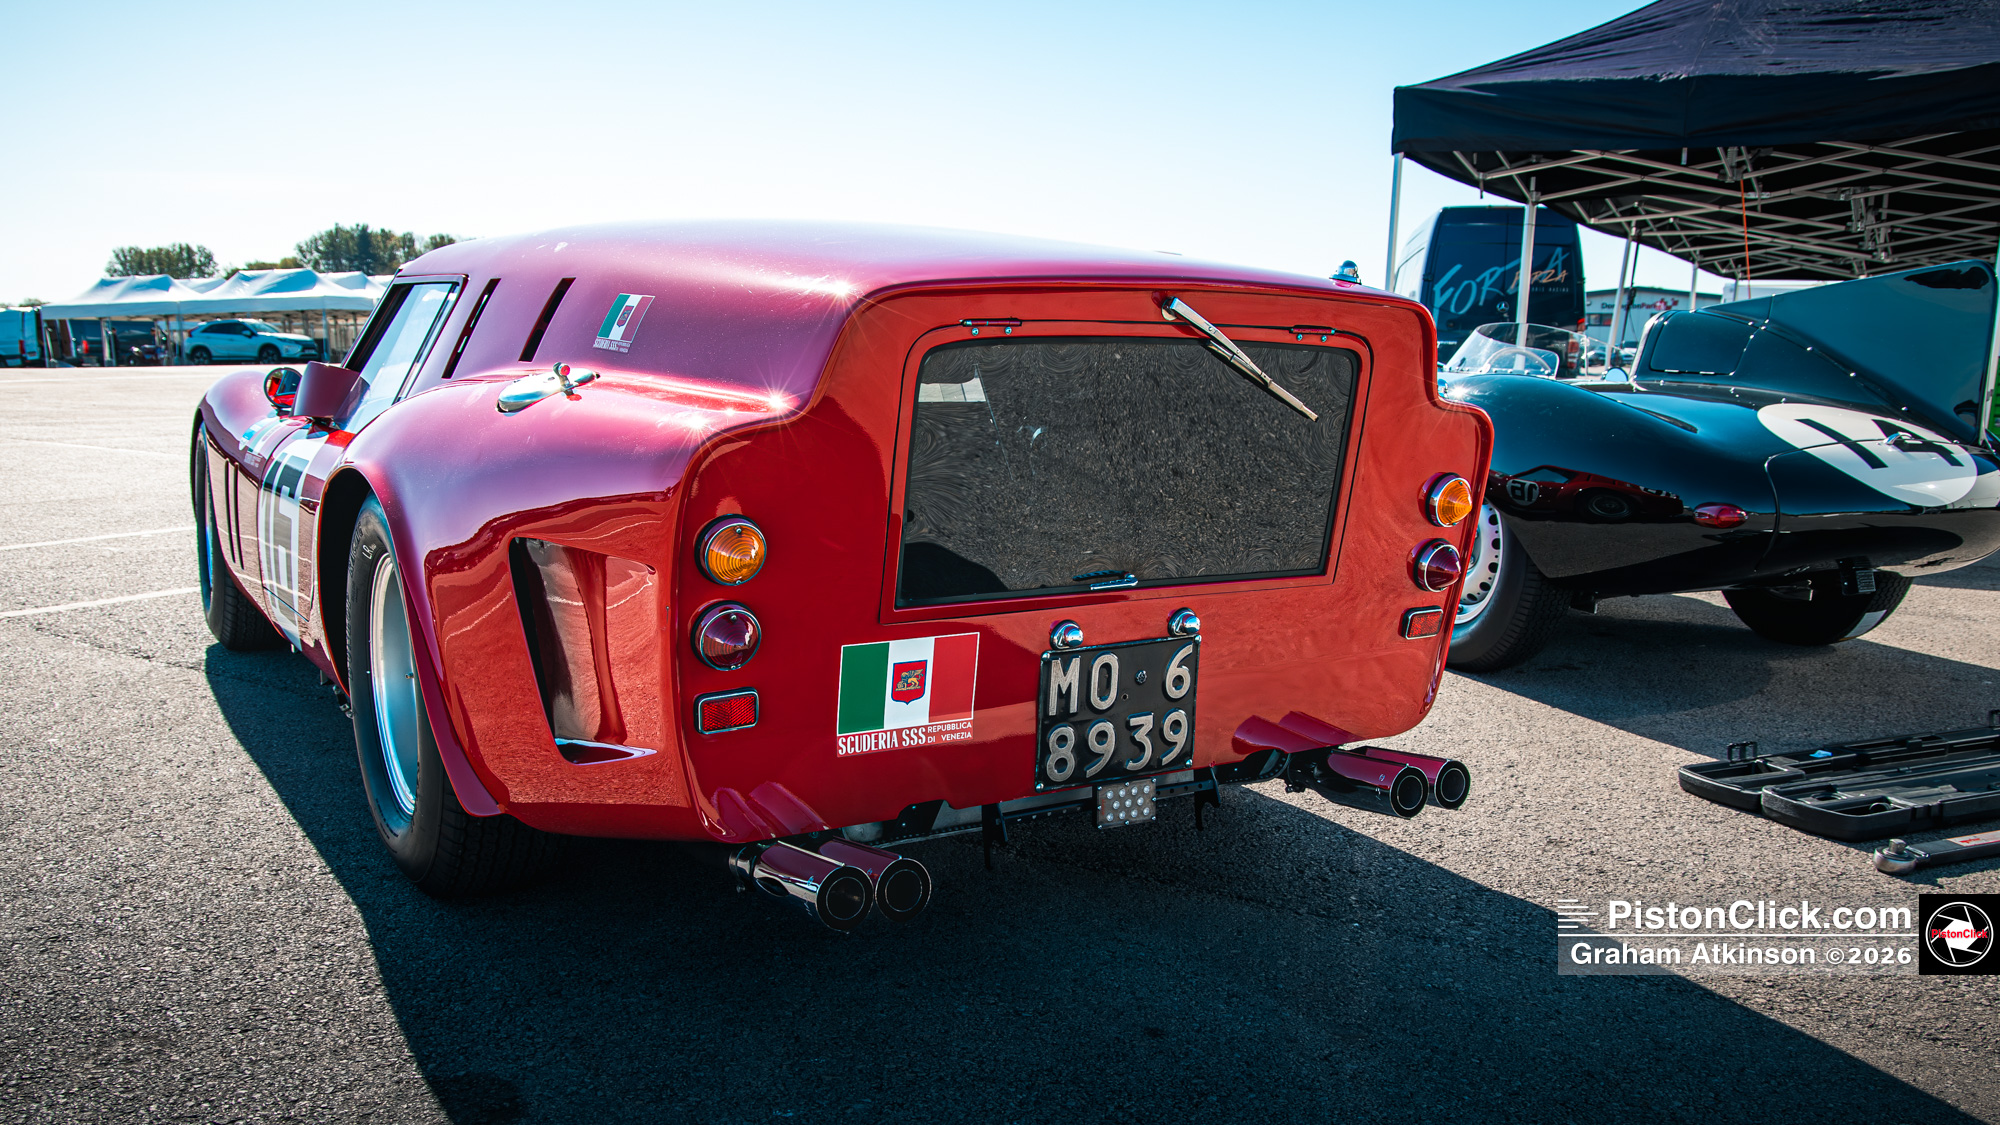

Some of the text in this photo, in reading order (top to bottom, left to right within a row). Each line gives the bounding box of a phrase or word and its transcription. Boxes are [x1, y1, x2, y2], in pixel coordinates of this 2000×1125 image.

[1511, 269, 1568, 289] RZA
[1795, 418, 1965, 469] 14
[1048, 641, 1193, 716] MO 6
[838, 727, 926, 755] SCUDERIA SSS
[927, 721, 972, 733] REPUBBLICA
[941, 731, 972, 741] VENEZIA
[1046, 708, 1189, 782] 8939
